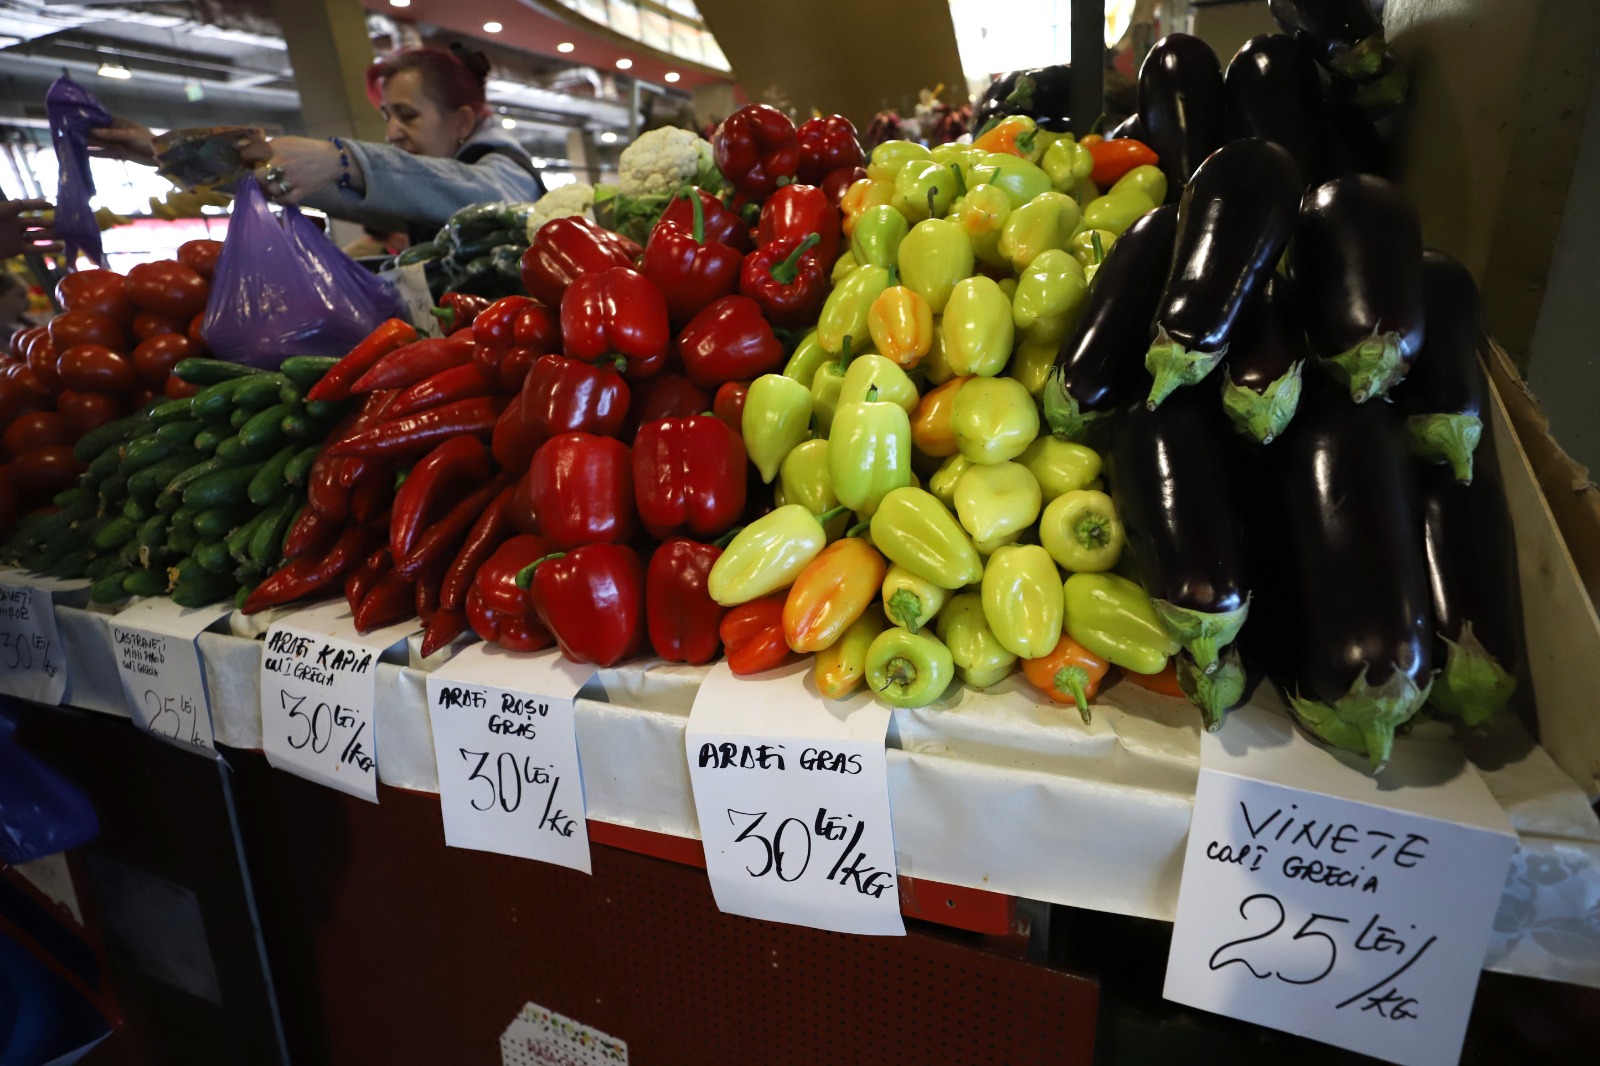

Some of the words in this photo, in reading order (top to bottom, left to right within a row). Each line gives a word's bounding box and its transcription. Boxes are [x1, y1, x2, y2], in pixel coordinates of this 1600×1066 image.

[280, 689, 332, 753] 30
[488, 714, 537, 740] GRAS
[458, 747, 522, 813] 30
[799, 747, 863, 775] GRAS
[727, 808, 812, 883] 30
[1209, 893, 1350, 985] 25
